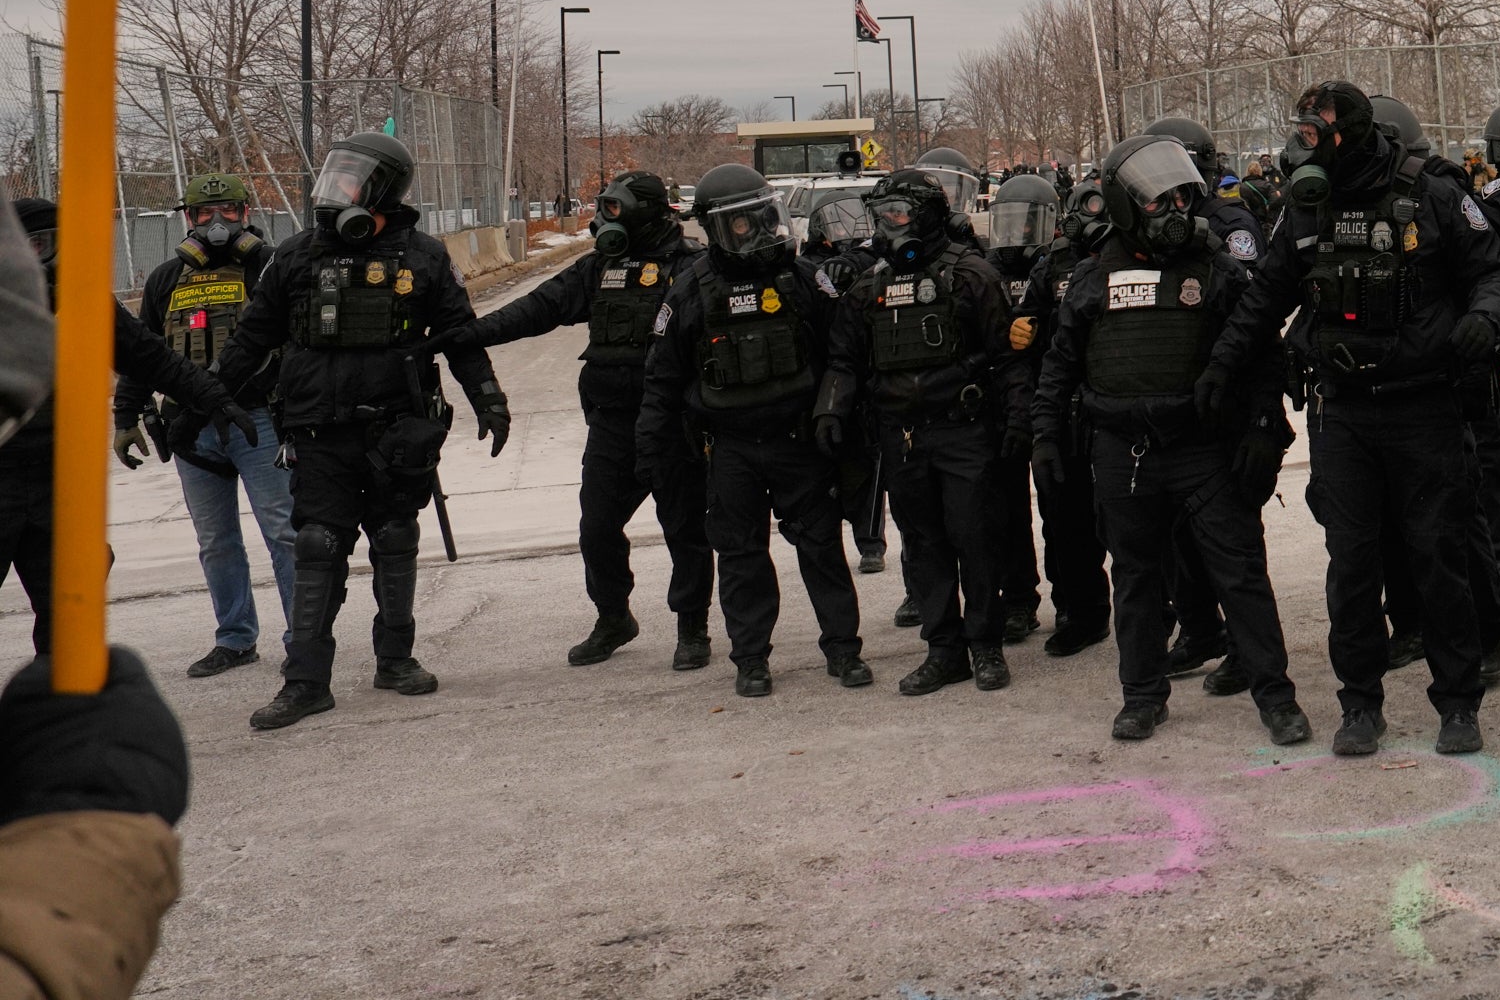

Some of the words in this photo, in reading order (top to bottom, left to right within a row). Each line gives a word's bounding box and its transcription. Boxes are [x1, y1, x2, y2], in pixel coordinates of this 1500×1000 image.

[1342, 211, 1364, 219] M-319
[1335, 222, 1367, 234] POLICE
[603, 269, 628, 281] POLICE
[175, 288, 205, 301] FEDERAL
[205, 285, 239, 296] OFFICER
[886, 282, 914, 298] POLICE
[1109, 284, 1156, 299] POLICE
[177, 297, 198, 306] BUREAU
[208, 293, 235, 302] PRISONS
[729, 294, 757, 307] POLICE
